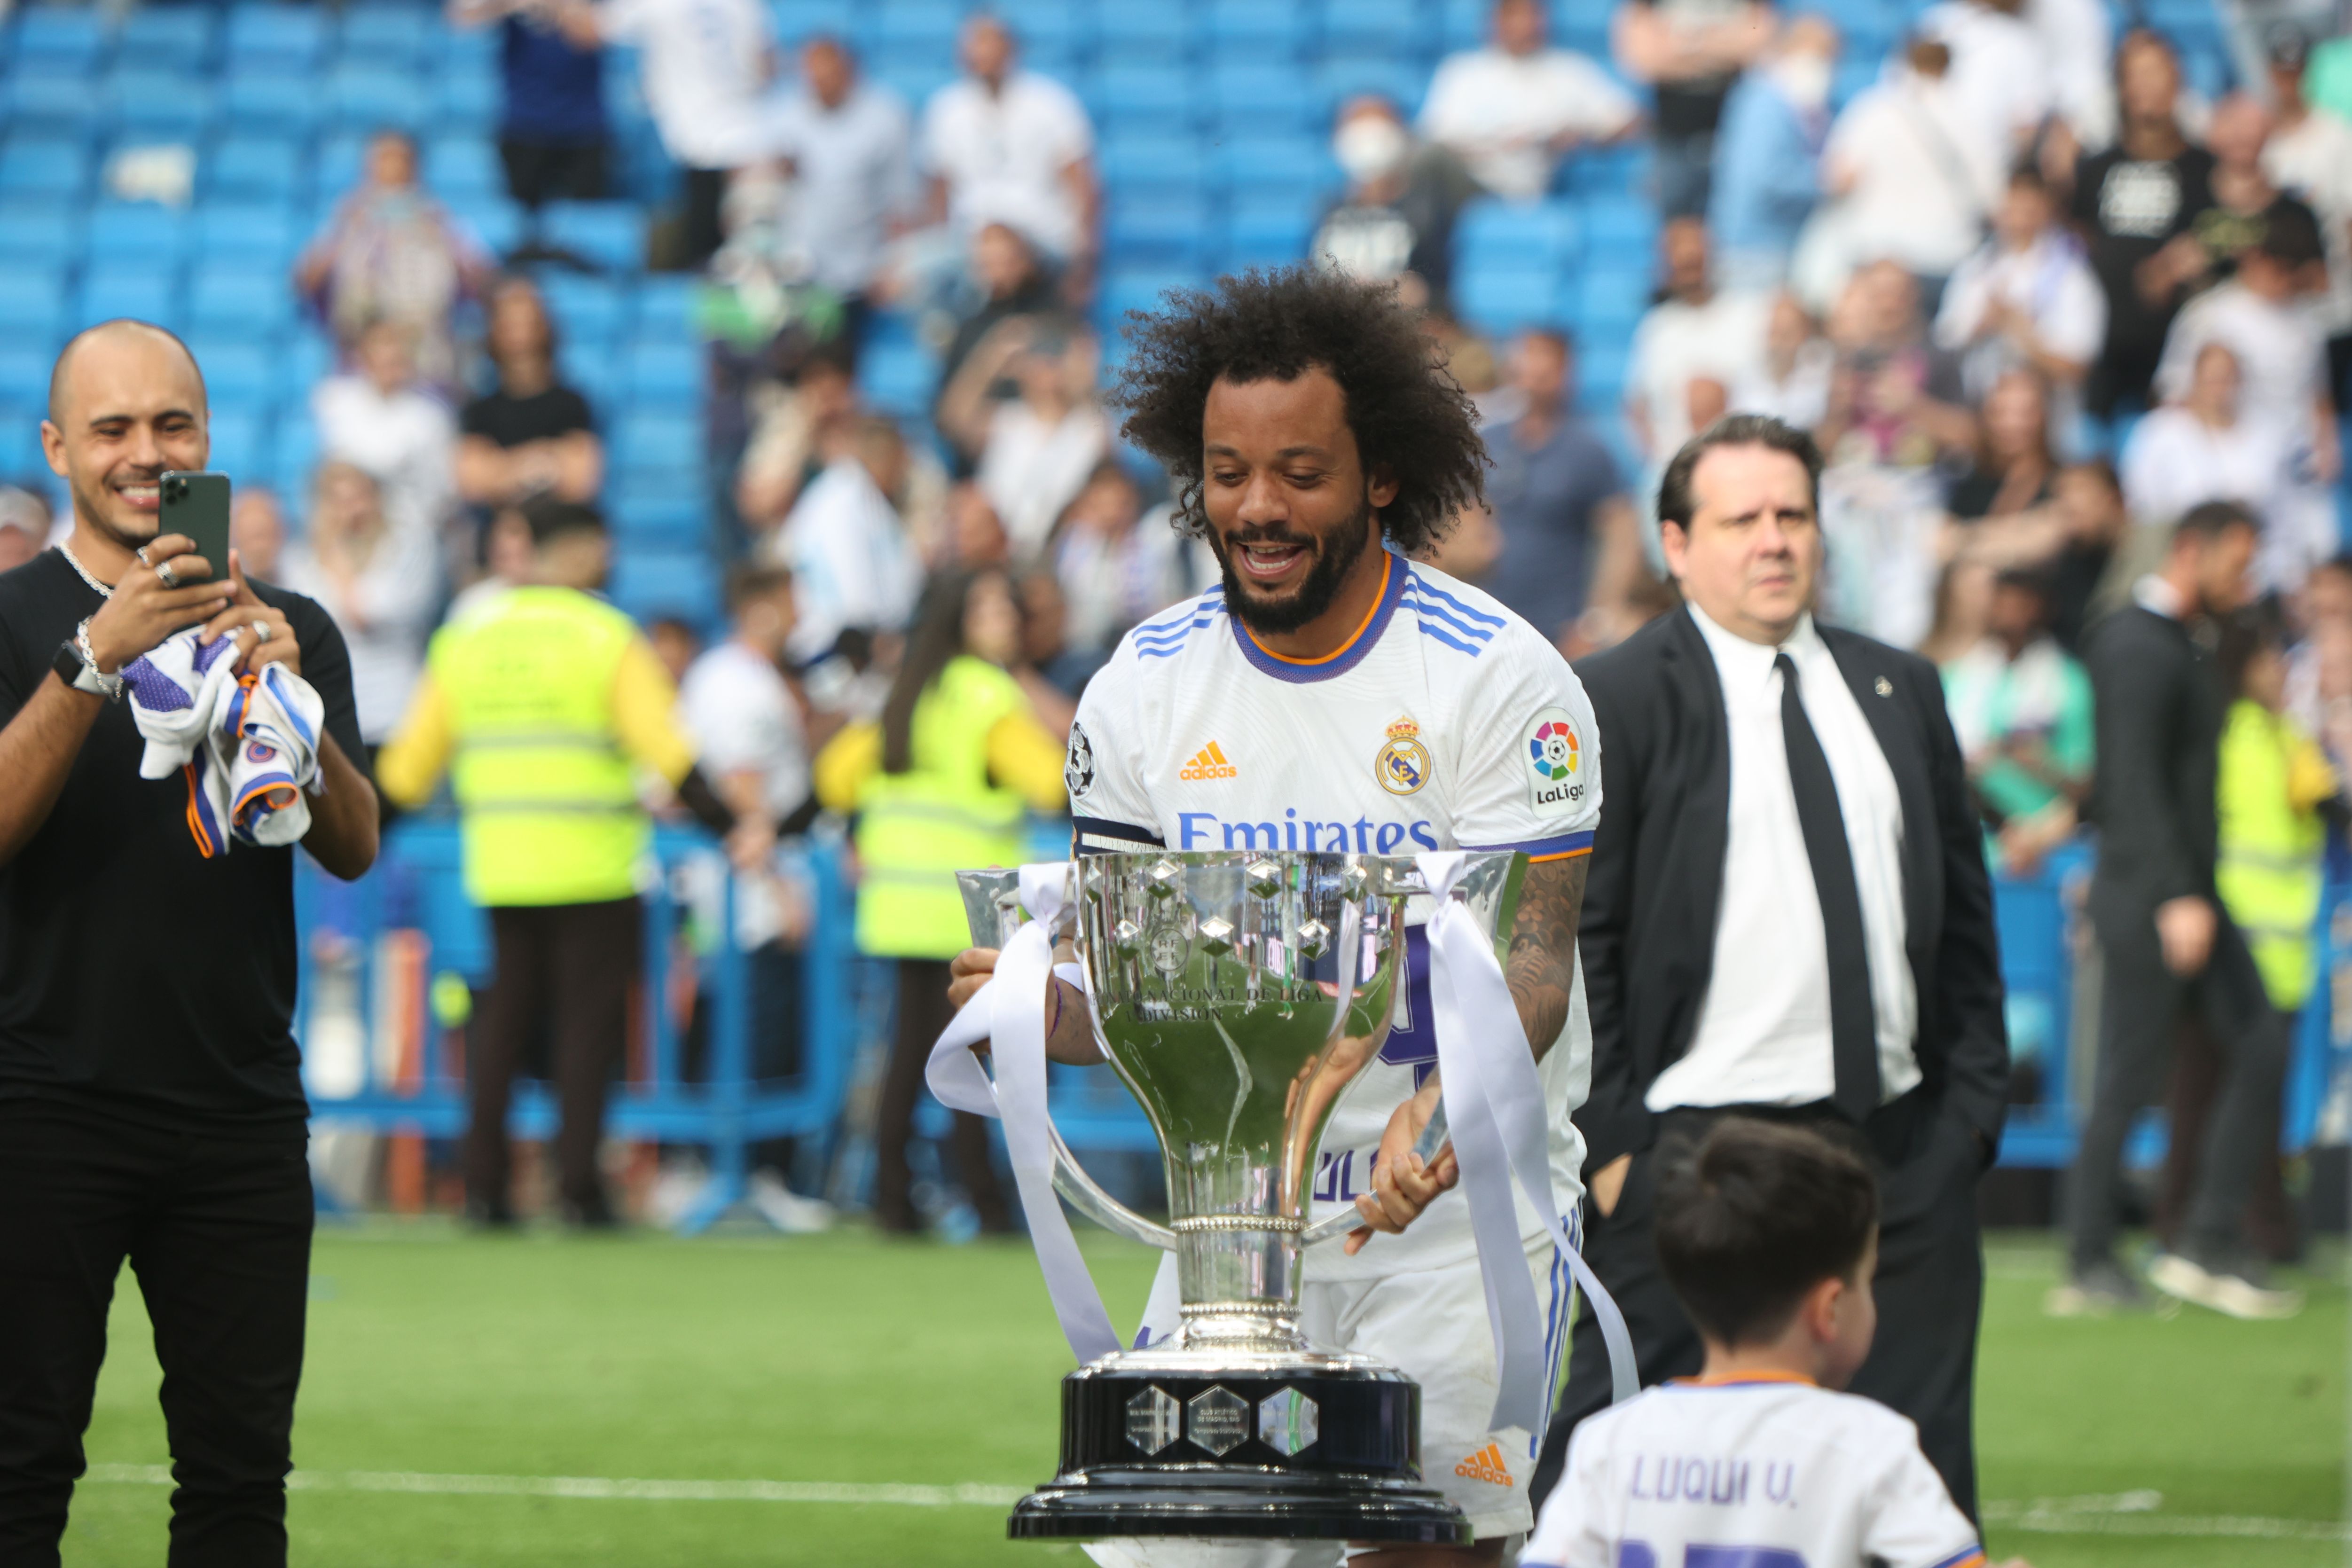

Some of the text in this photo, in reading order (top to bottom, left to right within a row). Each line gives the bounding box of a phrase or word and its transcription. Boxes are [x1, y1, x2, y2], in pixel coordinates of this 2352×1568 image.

[1180, 765, 1238, 781] adidas
[1537, 784, 1584, 805] LaLiga
[1177, 808, 1438, 855] Emirates
[1147, 988, 1241, 1003] NACIONAL
[1247, 988, 1270, 1001] DE
[1280, 988, 1323, 1002] LIGA
[1455, 1464, 1513, 1487] adidas
[1632, 1455, 1750, 1506] LUQUI
